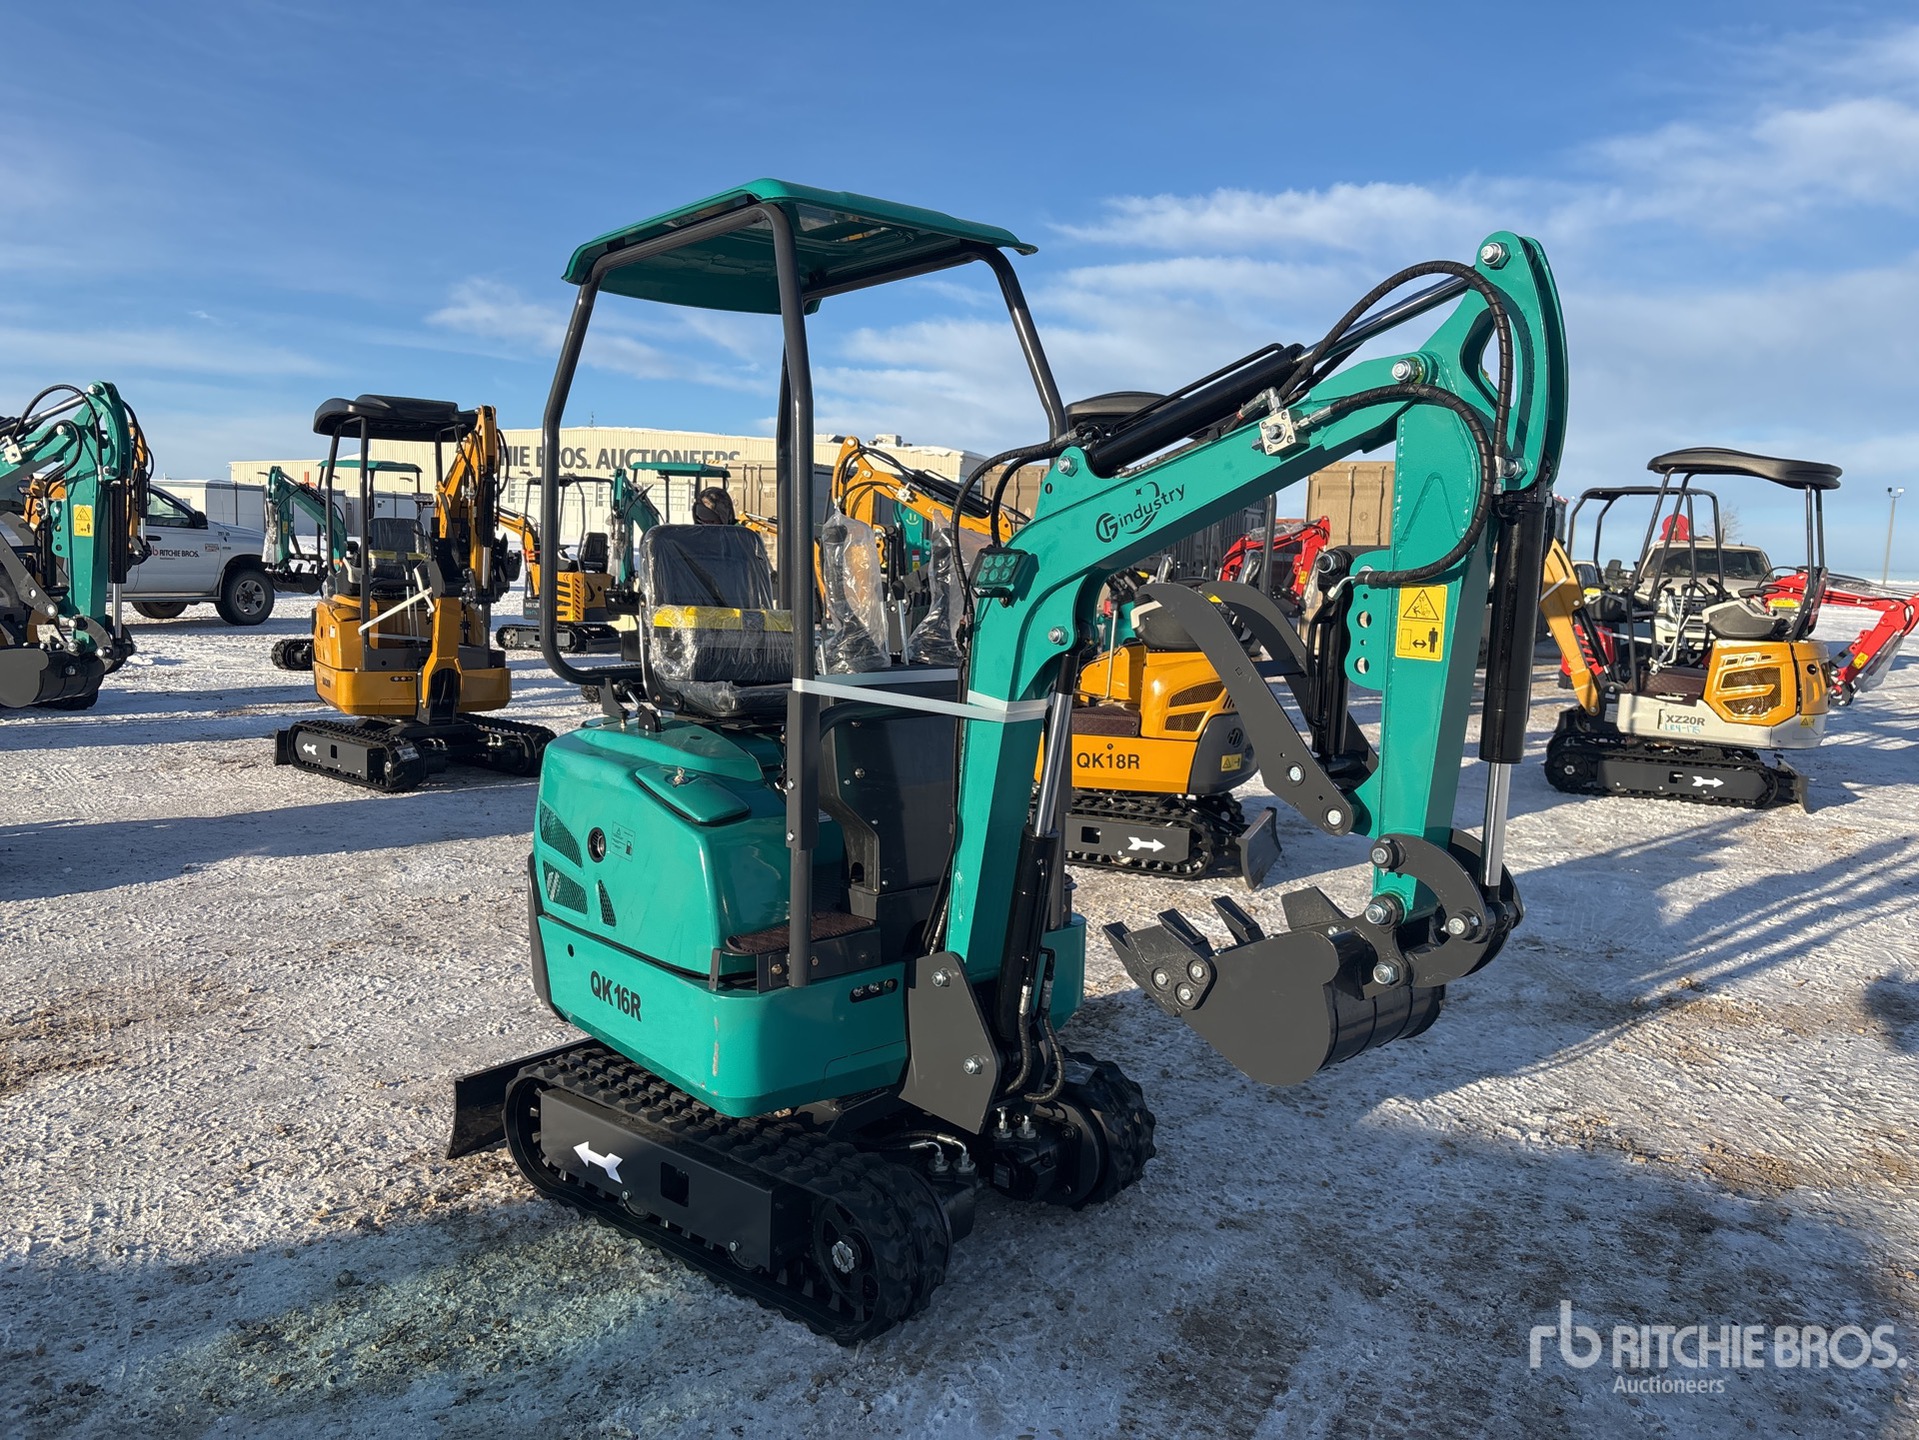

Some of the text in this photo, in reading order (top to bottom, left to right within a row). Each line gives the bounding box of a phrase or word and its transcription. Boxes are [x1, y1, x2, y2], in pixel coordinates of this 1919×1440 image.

[1666, 714, 1706, 726] XZ20R
[1076, 752, 1140, 769] QK18R
[590, 970, 642, 1022] QK16R
